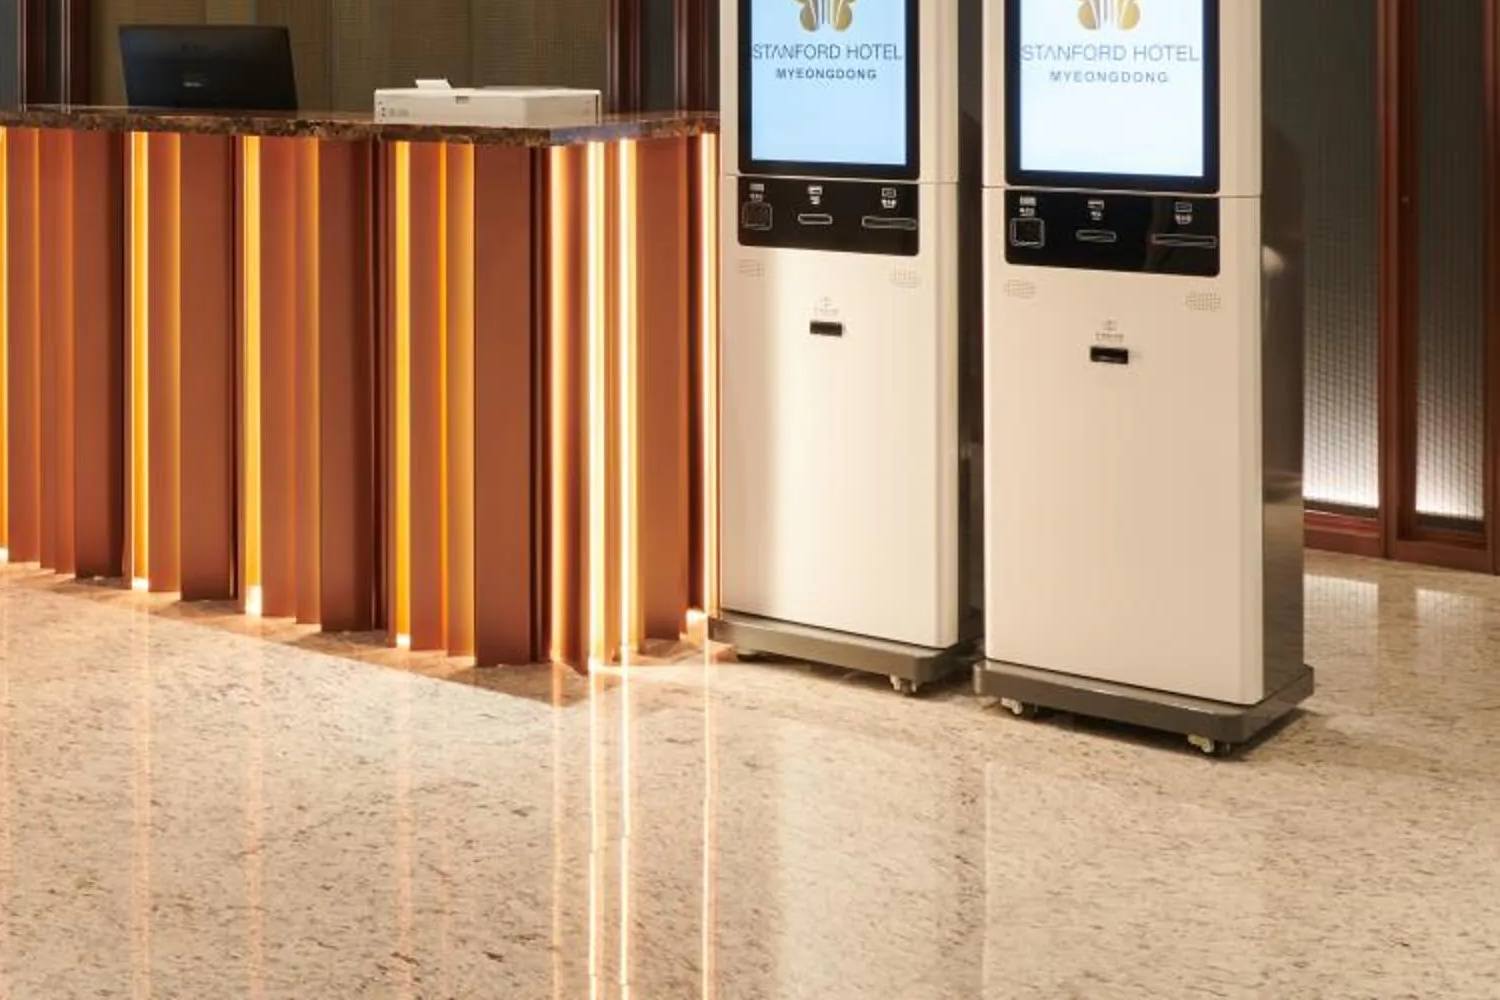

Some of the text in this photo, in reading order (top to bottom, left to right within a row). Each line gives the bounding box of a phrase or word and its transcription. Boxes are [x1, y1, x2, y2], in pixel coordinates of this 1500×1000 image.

[752, 43, 903, 61] STANFORD HOTEL
[1021, 44, 1200, 62] STANFORD HOTEL
[775, 67, 877, 80] MYEONGDONG
[1050, 70, 1169, 83] MYEONGDONG
